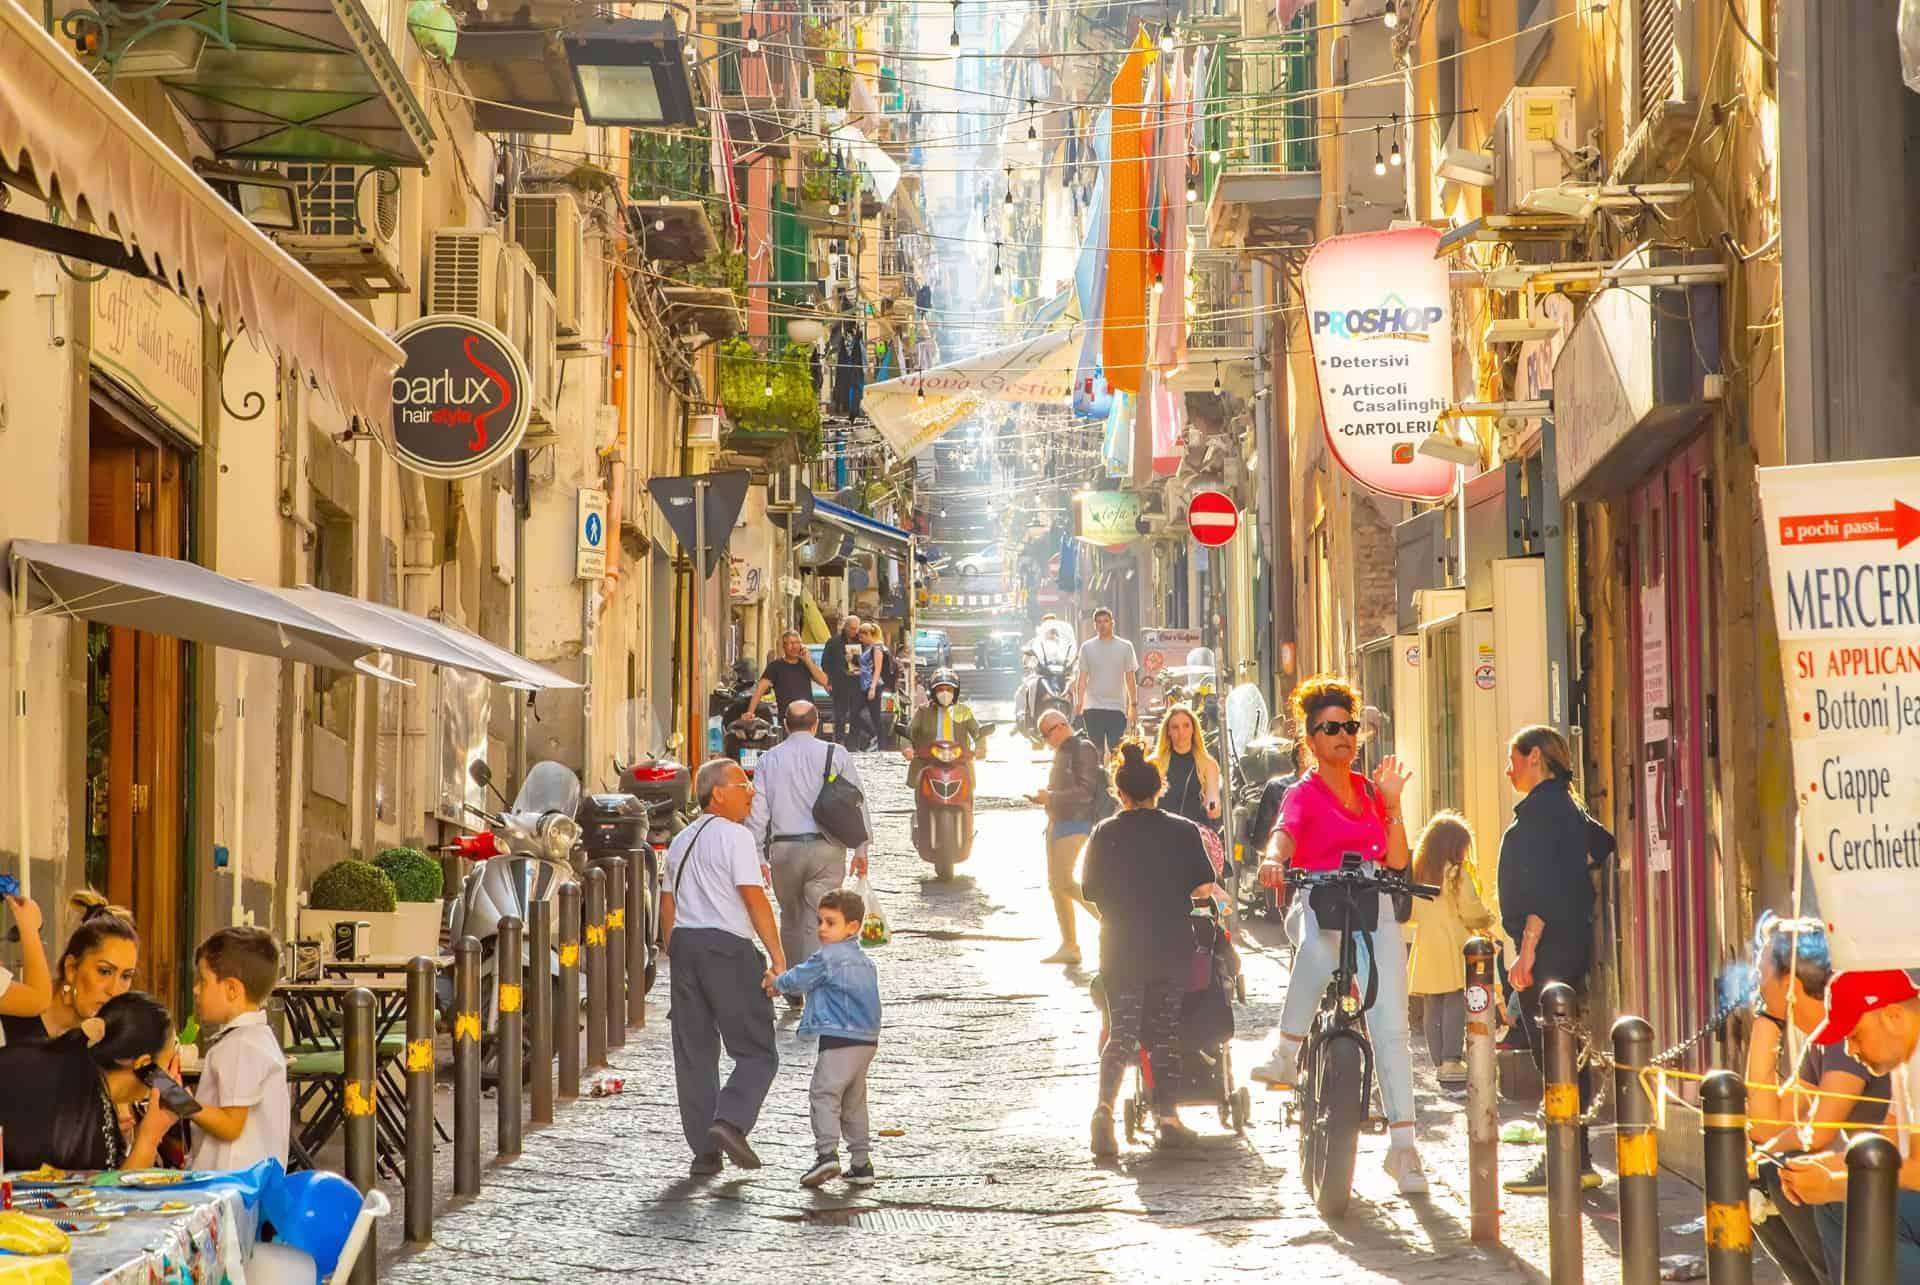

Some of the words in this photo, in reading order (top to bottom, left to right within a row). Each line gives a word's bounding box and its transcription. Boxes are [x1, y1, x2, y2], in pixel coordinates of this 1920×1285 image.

[1313, 306, 1443, 341] PROSHOP
[1330, 354, 1410, 369] Detersivi
[1342, 382, 1408, 397] Articoli
[1352, 398, 1447, 414] Casalinghi
[1784, 528, 1794, 539] a
[1797, 519, 1840, 542] pochi
[1797, 650, 1815, 679] SI
[1815, 682, 1889, 731] Bottoni
[1822, 756, 1892, 815] Ciappe
